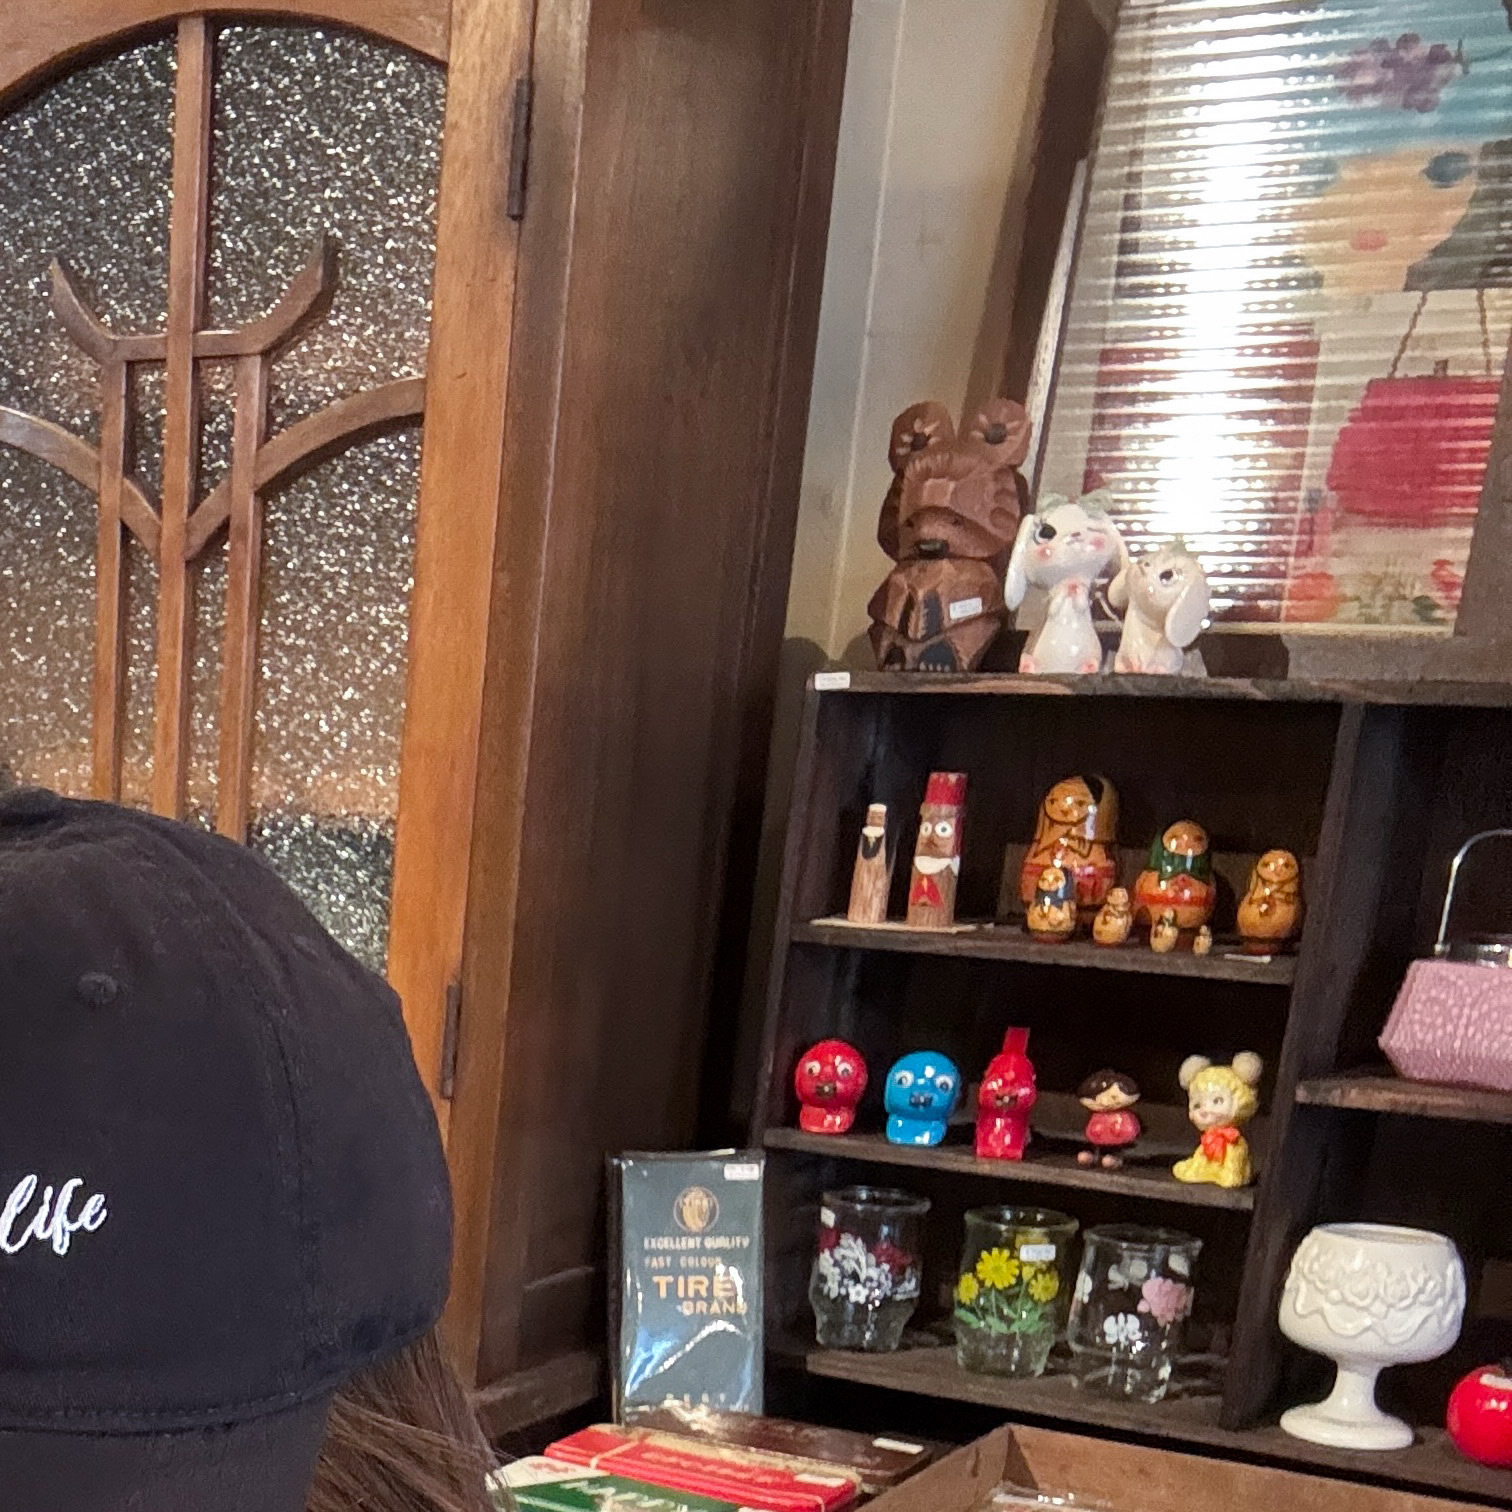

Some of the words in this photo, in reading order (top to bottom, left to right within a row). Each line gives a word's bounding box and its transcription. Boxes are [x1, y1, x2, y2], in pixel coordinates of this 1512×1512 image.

[644, 1235, 701, 1250] EXCELLENT
[704, 1235, 750, 1250] QUALITY
[644, 1255, 672, 1269] FAST
[652, 1275, 737, 1299] TIRE
